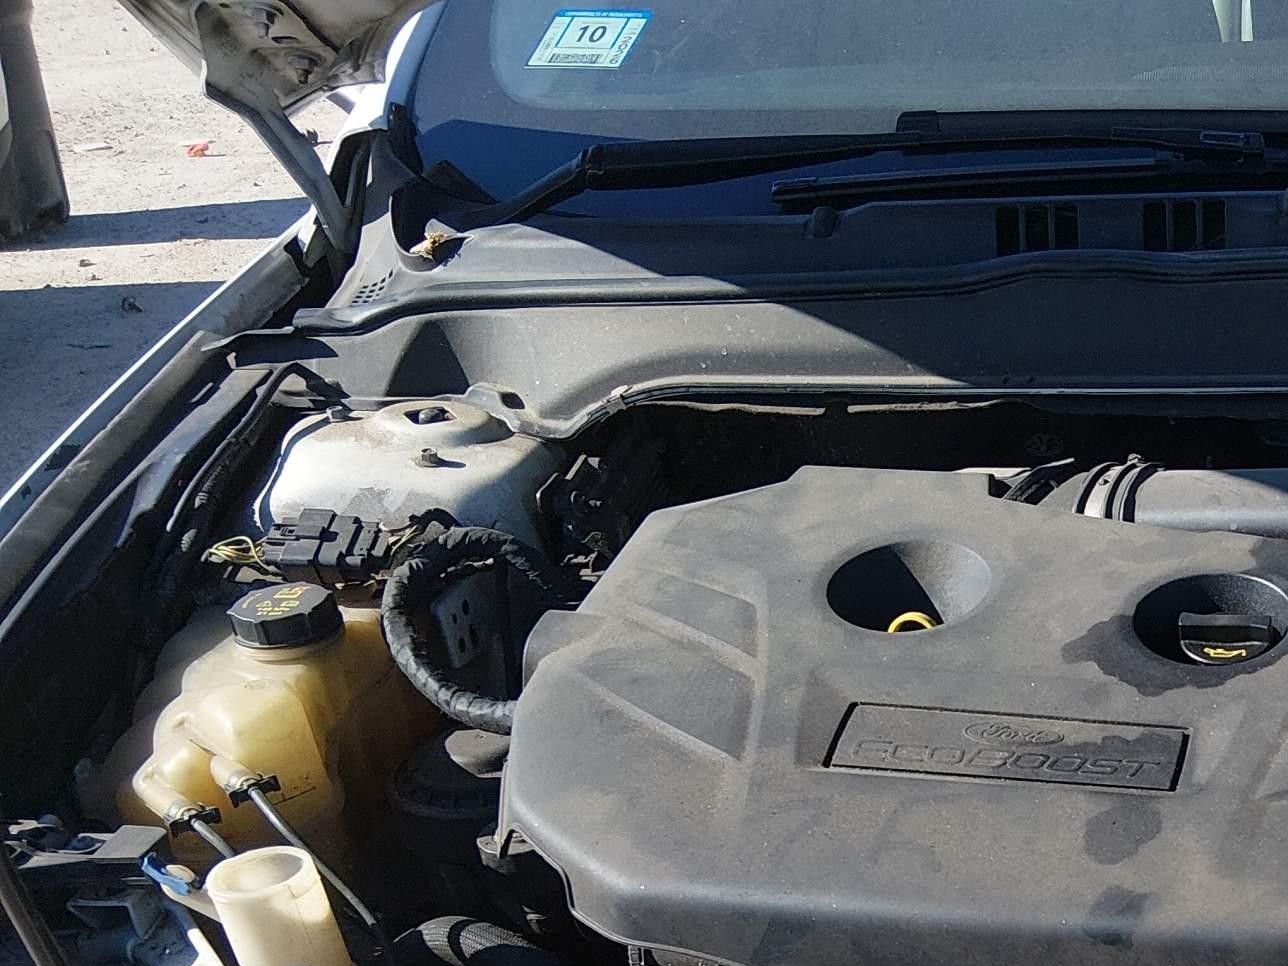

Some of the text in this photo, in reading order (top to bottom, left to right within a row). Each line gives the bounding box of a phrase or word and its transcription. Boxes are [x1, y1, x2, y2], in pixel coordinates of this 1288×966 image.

[576, 25, 608, 43] 10
[986, 722, 1046, 743] Ford
[853, 740, 1160, 777] ECOBOOST
